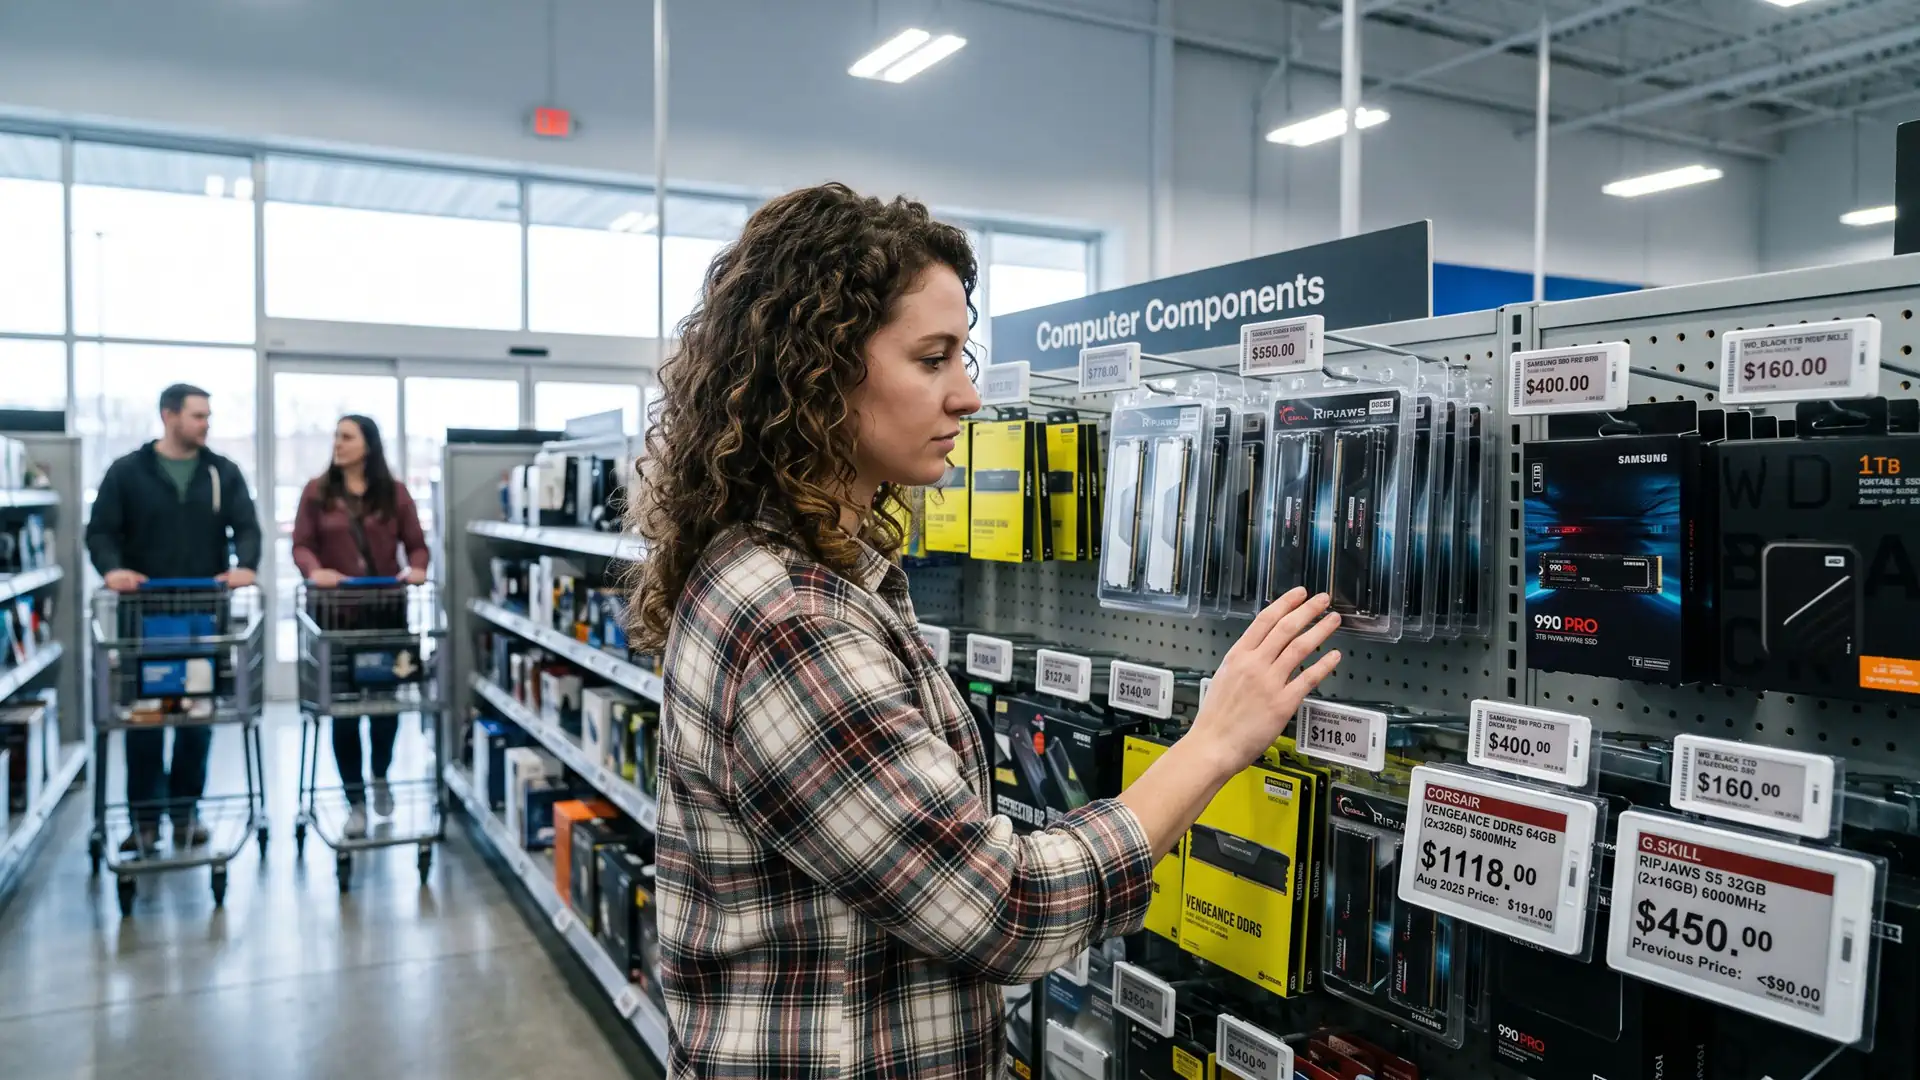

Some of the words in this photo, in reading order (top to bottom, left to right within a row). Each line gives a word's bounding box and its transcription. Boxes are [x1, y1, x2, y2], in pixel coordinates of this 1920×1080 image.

[1036, 310, 1140, 352] Computer
[1145, 272, 1325, 331] Components
[1252, 342, 1295, 361] $550.00
[1526, 357, 1557, 368] SAMSUNG
[1744, 357, 1827, 382] $160.00
[1526, 375, 1590, 396] $400.00
[1312, 407, 1366, 420] RIPJAWS
[1617, 453, 1668, 465] SAMSUNG
[1858, 454, 1901, 475] 1TB
[1534, 614, 1562, 630] 990
[1564, 616, 1598, 634] PRO
[1119, 682, 1152, 699] $140.00
[1488, 714, 1518, 725] SAMSUNG
[1529, 720, 1542, 729] PRO
[1311, 725, 1356, 746] $118.00
[1488, 731, 1551, 757] $400.00
[1427, 786, 1481, 810] CORSAIR
[1697, 771, 1781, 802] $160.00
[1425, 803, 1491, 829] VENGEANCE
[1492, 819, 1524, 836] DDR5
[1526, 827, 1557, 845] 64GB
[1469, 828, 1517, 850] 5600MHz
[1641, 836, 1702, 862] G.SKILL
[1420, 839, 1537, 891] $1118.00
[1639, 855, 1702, 880] RIPJAWS
[1704, 869, 1723, 886] S5
[1727, 875, 1767, 897] 32GB
[1416, 872, 1438, 890] Aug
[1439, 878, 1465, 896] 2025
[1467, 886, 1500, 907] Price:
[1508, 898, 1553, 922] $191.00
[1637, 870, 1698, 899] (2x16GB)
[1701, 887, 1767, 914] 6000MHz
[1186, 892, 1236, 928] VENGEANCE
[1635, 898, 1773, 958] $450.00
[1632, 936, 1695, 966] Previous
[1698, 955, 1743, 981] Price:
[1756, 973, 1821, 1003] <$90.00
[1497, 1023, 1519, 1042] 990
[1519, 1032, 1545, 1053] PRO
